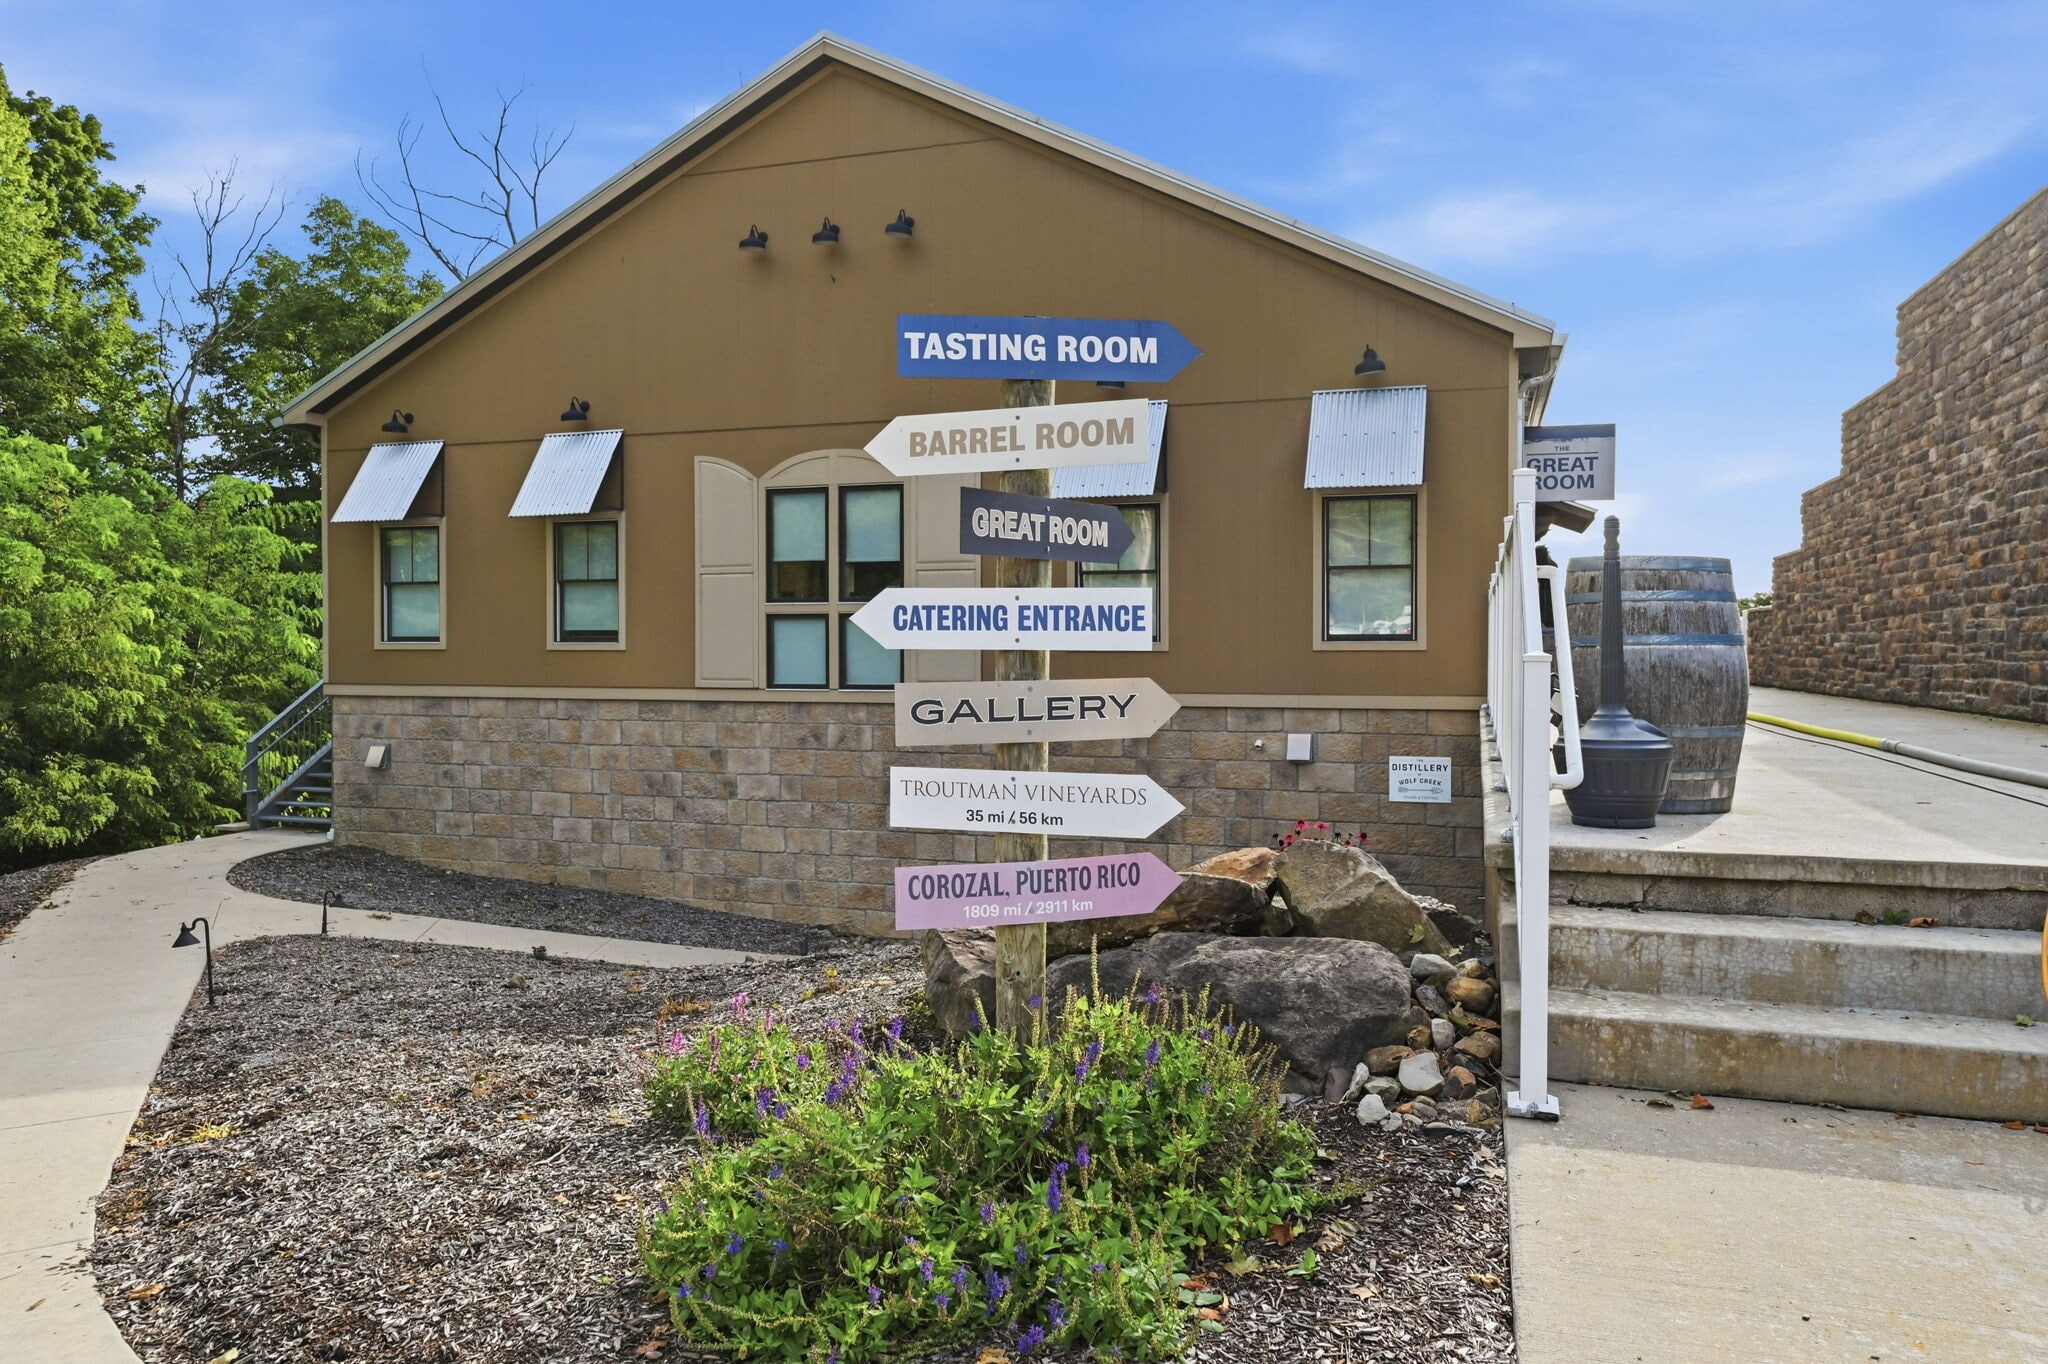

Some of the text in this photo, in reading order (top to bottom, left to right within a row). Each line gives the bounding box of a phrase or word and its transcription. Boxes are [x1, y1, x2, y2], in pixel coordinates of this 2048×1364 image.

[904, 332, 1157, 364] TASTING ROOM
[909, 417, 1134, 457] BARREL ROOM
[1527, 457, 1598, 472] GREAT
[972, 507, 1108, 547] GREAT ROOM
[893, 604, 1145, 631] CATERING ENTRANCE
[911, 694, 1138, 725] GALLERY
[1392, 763, 1448, 771] DISTILLERY
[901, 780, 1147, 805] TROUTMAN VINEYARDS
[1420, 778, 1442, 786] CREEK
[966, 809, 984, 822] 35
[988, 811, 1004, 823] mi
[1019, 812, 1037, 824] 56
[1042, 812, 1063, 826] km
[908, 861, 1140, 900] COROZAL, PUERTO RICO
[963, 905, 999, 918] 1809
[1003, 903, 1021, 916] mi
[1036, 900, 1068, 913] 2911
[1072, 899, 1093, 911] km
